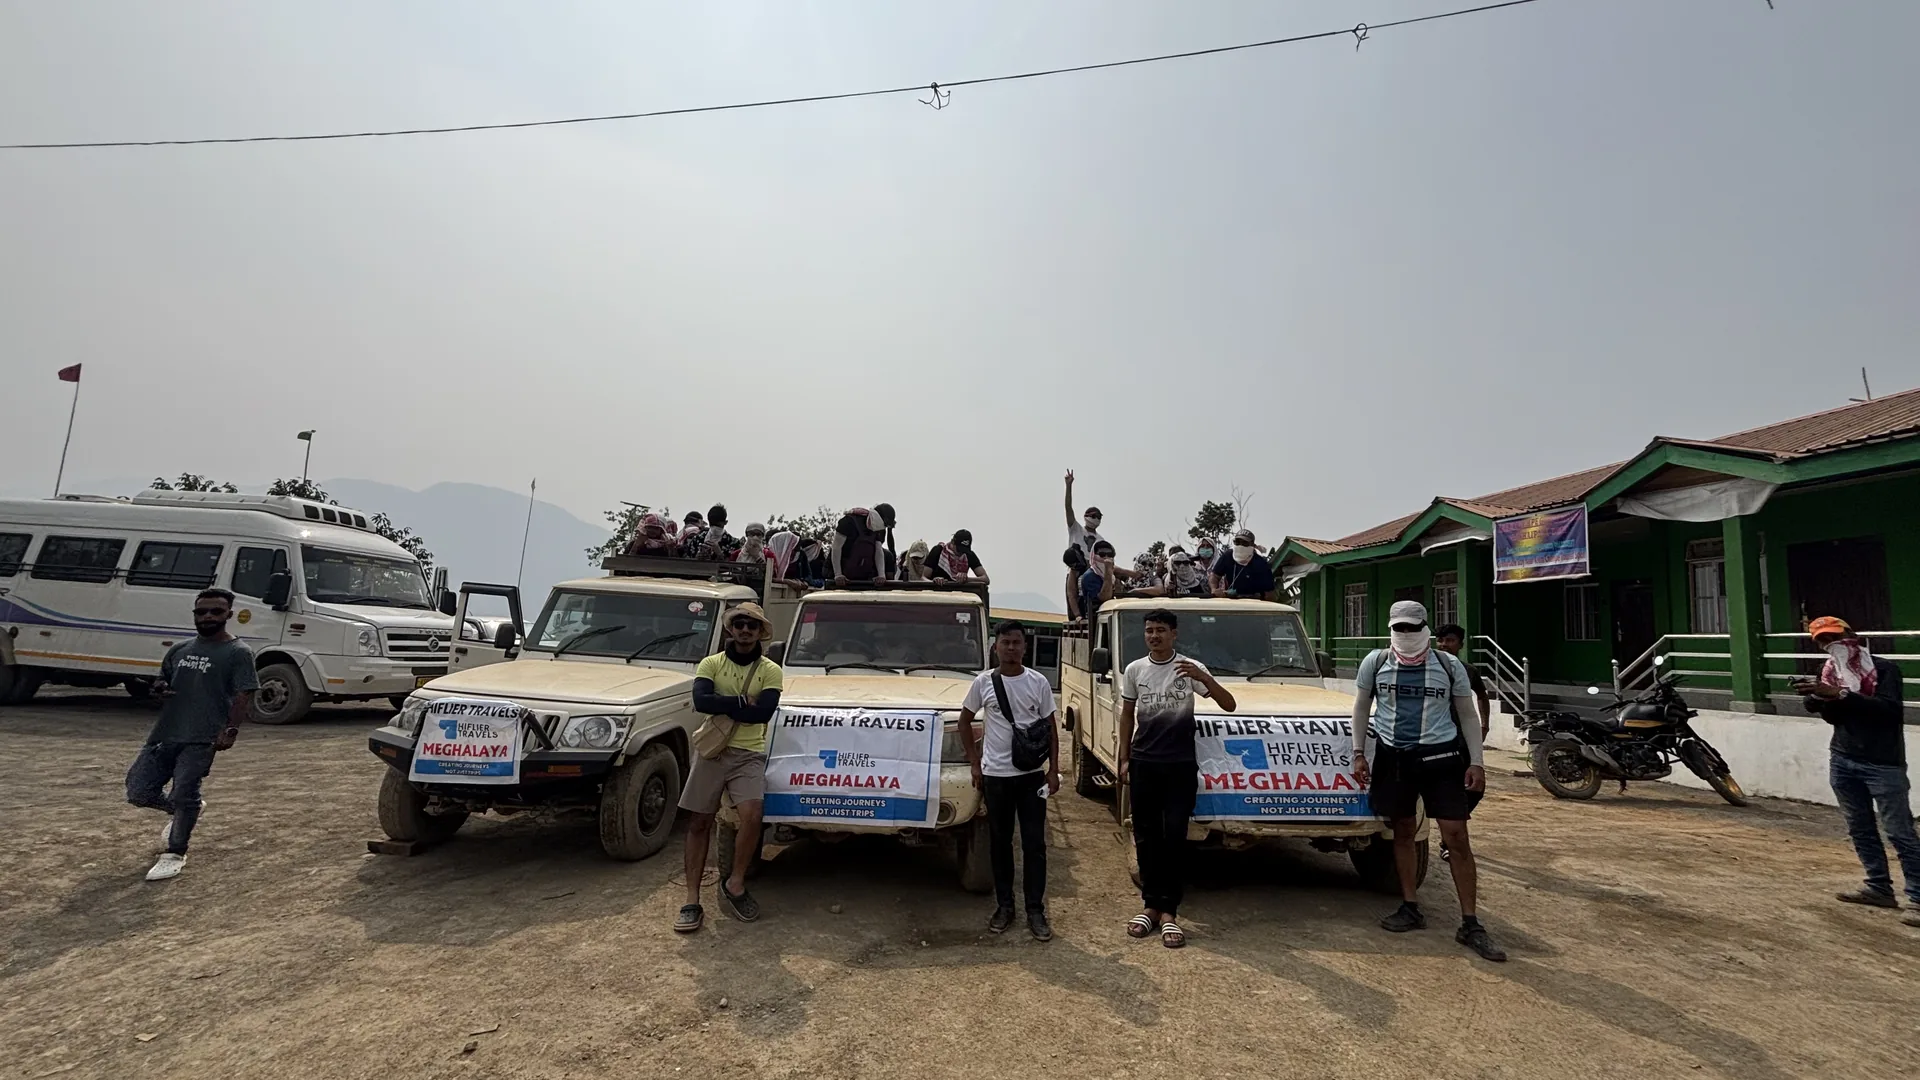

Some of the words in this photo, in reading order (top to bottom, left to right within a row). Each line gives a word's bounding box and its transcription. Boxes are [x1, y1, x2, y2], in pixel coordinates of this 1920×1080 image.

[1141, 691, 1186, 704] ETIHAD
[1379, 683, 1446, 699] FASTER
[427, 702, 467, 715] HIFLIER
[468, 705, 519, 718] TRAVELS
[1150, 702, 1180, 710] AIRWAYS
[458, 723, 490, 732] HIFLIER
[783, 715, 844, 728] HIFLIER
[850, 715, 925, 732] TRAVELS
[1195, 719, 1275, 738] HIFLIER
[1276, 720, 1377, 739] TRAVES
[458, 730, 498, 738] TRAVELS
[423, 743, 508, 757] MEGHALAYA
[1267, 742, 1333, 755] HIFLIER
[838, 752, 869, 761] HIFLIER
[838, 759, 876, 767] TRAVELS
[1268, 753, 1350, 767] TRAVELS
[790, 773, 901, 789] MEGHALAYA
[800, 797, 841, 806] CREATING
[842, 798, 886, 807] JOURNEYS
[1244, 796, 1298, 804] CREATING
[1300, 796, 1358, 804] JOURNEYS
[811, 808, 829, 816] NOT
[830, 809, 850, 817] JUST
[851, 809, 875, 817] TRIPS
